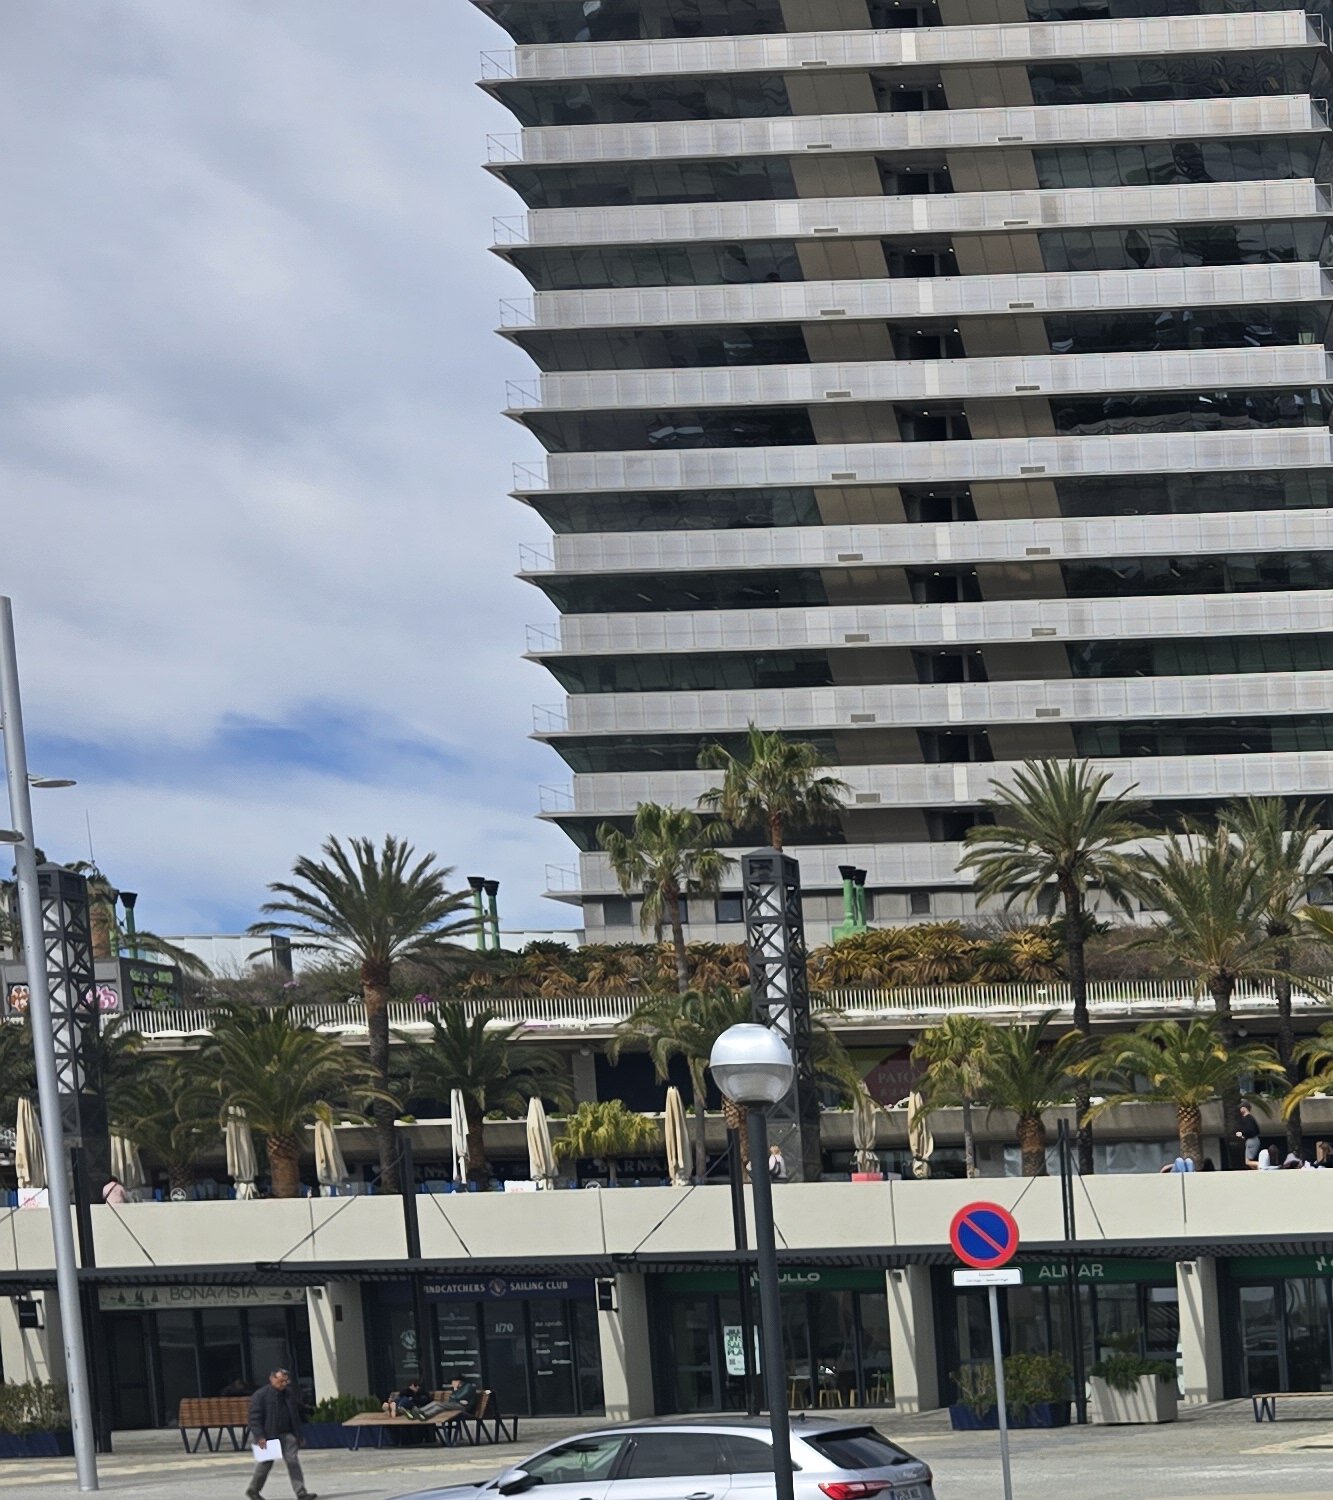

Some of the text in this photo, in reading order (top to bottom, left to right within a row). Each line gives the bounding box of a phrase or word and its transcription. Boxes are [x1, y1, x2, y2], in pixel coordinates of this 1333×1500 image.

[776, 1272, 821, 1283] ULLO
[424, 1280, 569, 1294] INDCATCHERS SAILING CLUB
